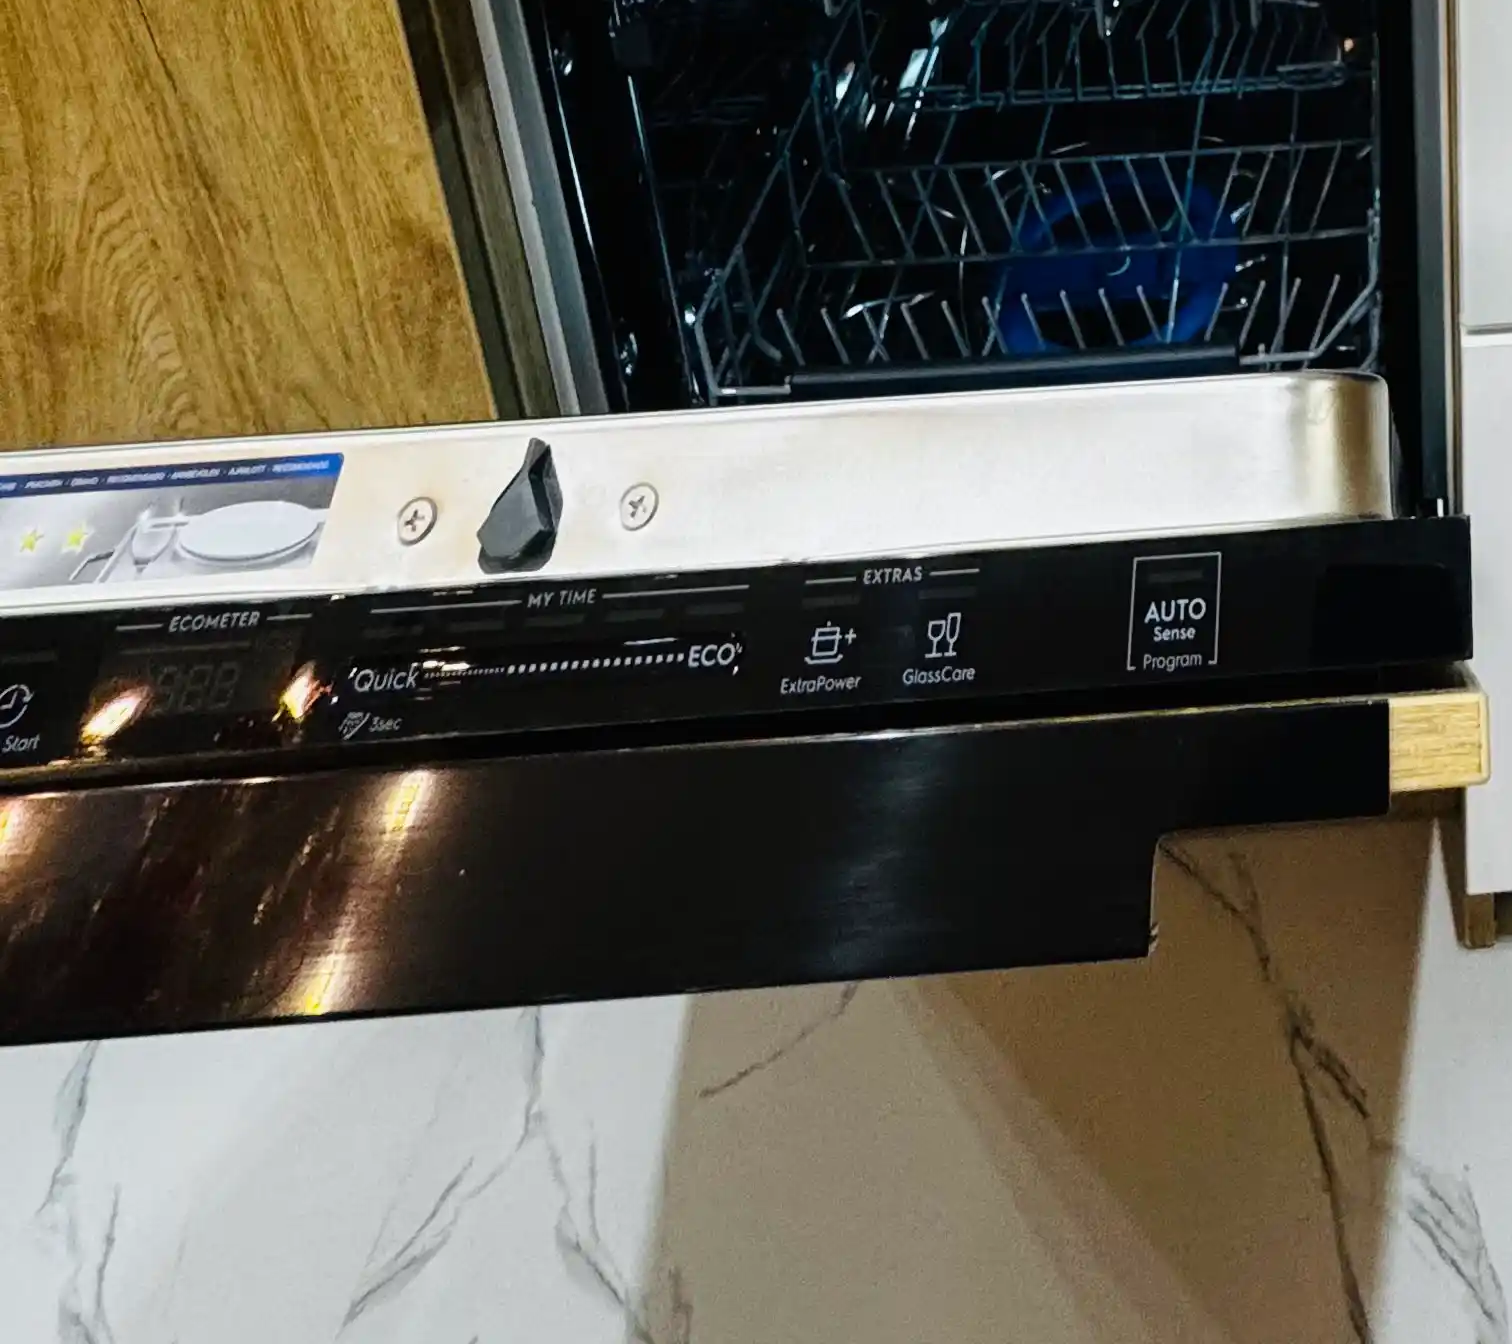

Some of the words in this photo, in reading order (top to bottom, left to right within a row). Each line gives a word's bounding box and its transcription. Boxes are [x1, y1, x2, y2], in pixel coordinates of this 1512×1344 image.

[863, 566, 923, 585] EXTRAS
[526, 592, 554, 608] MY
[559, 588, 597, 605] TIME
[1144, 598, 1207, 623] AUTO
[168, 611, 261, 633] ECOMETER
[1153, 626, 1196, 642] Sense
[354, 662, 420, 692] Quick
[688, 642, 736, 668] ECO
[1143, 654, 1203, 672] Program
[780, 674, 862, 695] ExtraPower
[902, 666, 976, 685] GlassCare
[368, 716, 402, 732] 3sec
[1, 733, 41, 753] Start
